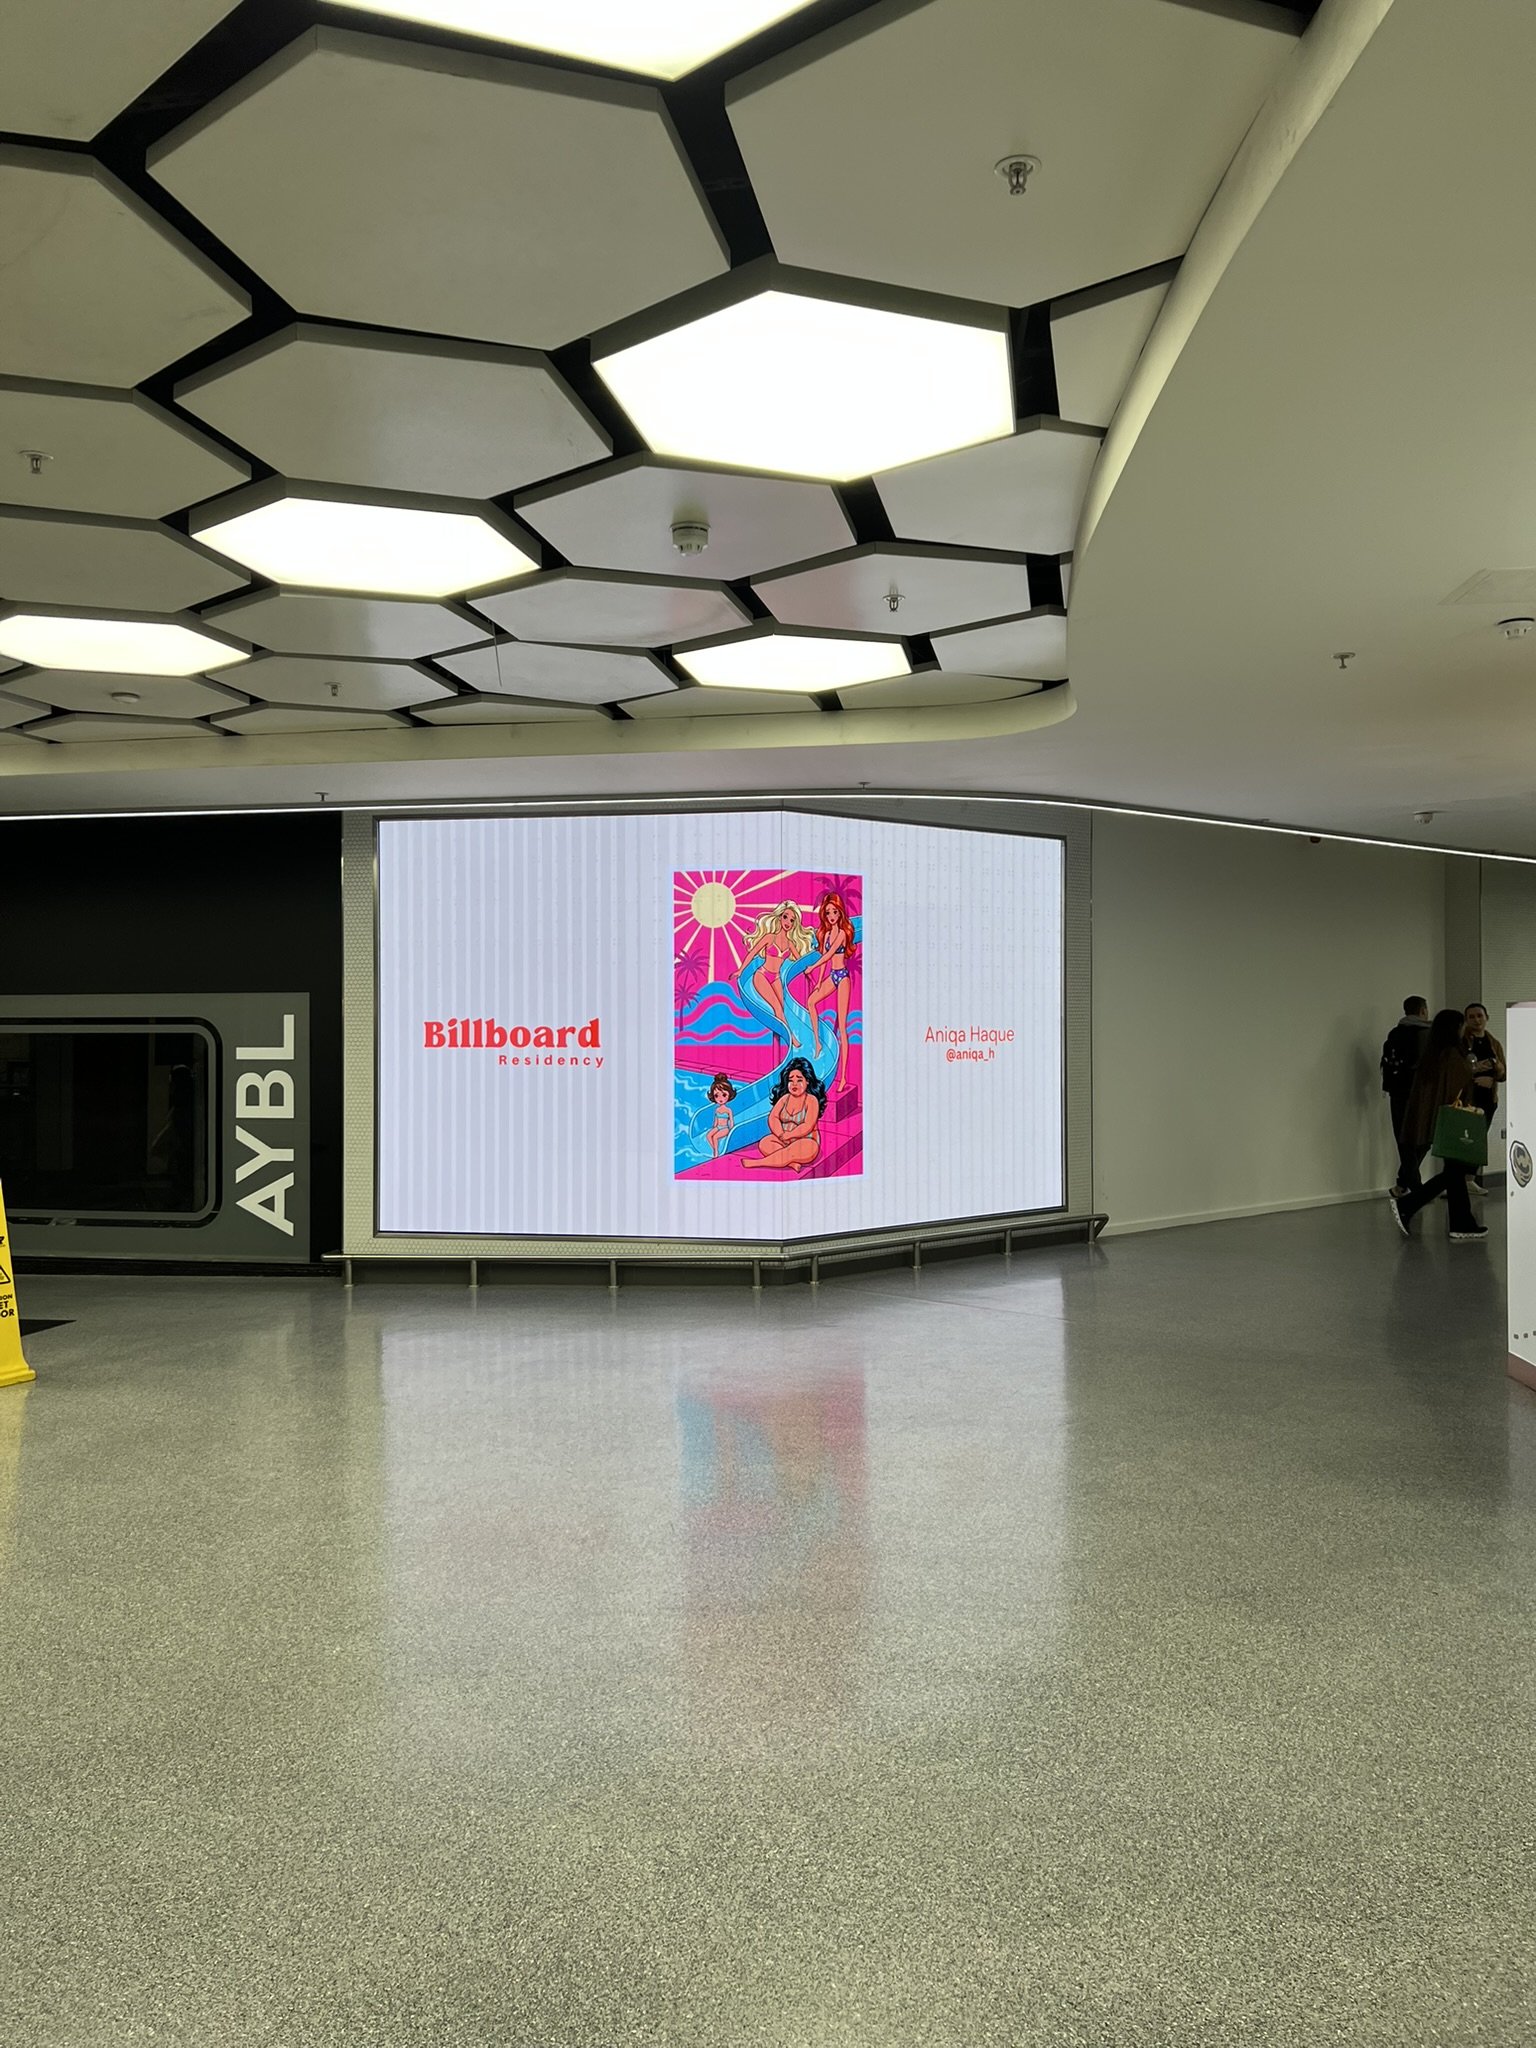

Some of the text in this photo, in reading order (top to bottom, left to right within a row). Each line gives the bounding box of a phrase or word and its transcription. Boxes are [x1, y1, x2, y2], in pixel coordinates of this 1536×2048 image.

[424, 1018, 601, 1048] Billboard
[925, 1025, 1015, 1046] Aniqa Haque
[499, 1055, 604, 1068] Residency
[946, 1048, 995, 1062] @aniqa_h
[235, 1014, 295, 1237] AYBL
